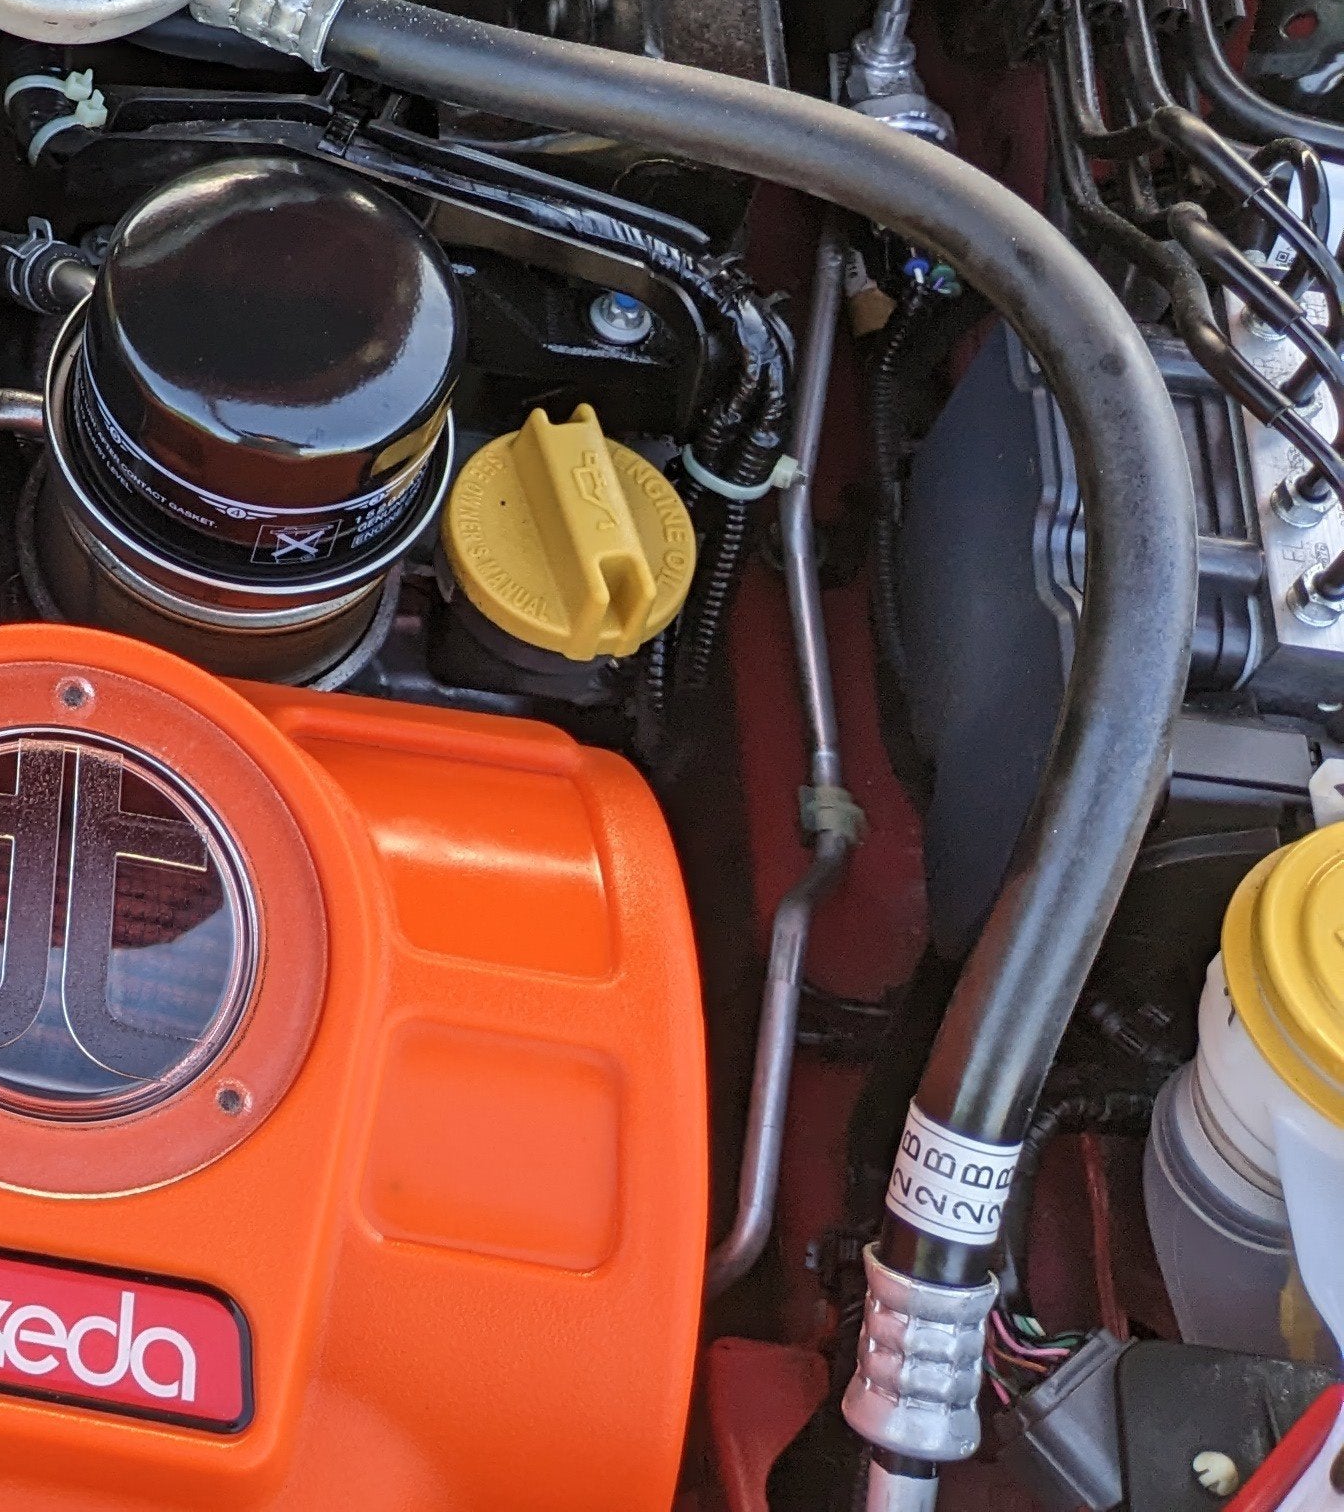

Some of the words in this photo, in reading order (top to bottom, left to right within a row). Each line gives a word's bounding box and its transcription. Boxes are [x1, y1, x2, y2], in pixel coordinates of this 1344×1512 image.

[121, 463, 166, 503] CONTACT
[168, 502, 218, 528] GASKET.
[614, 447, 678, 536] ENGINE
